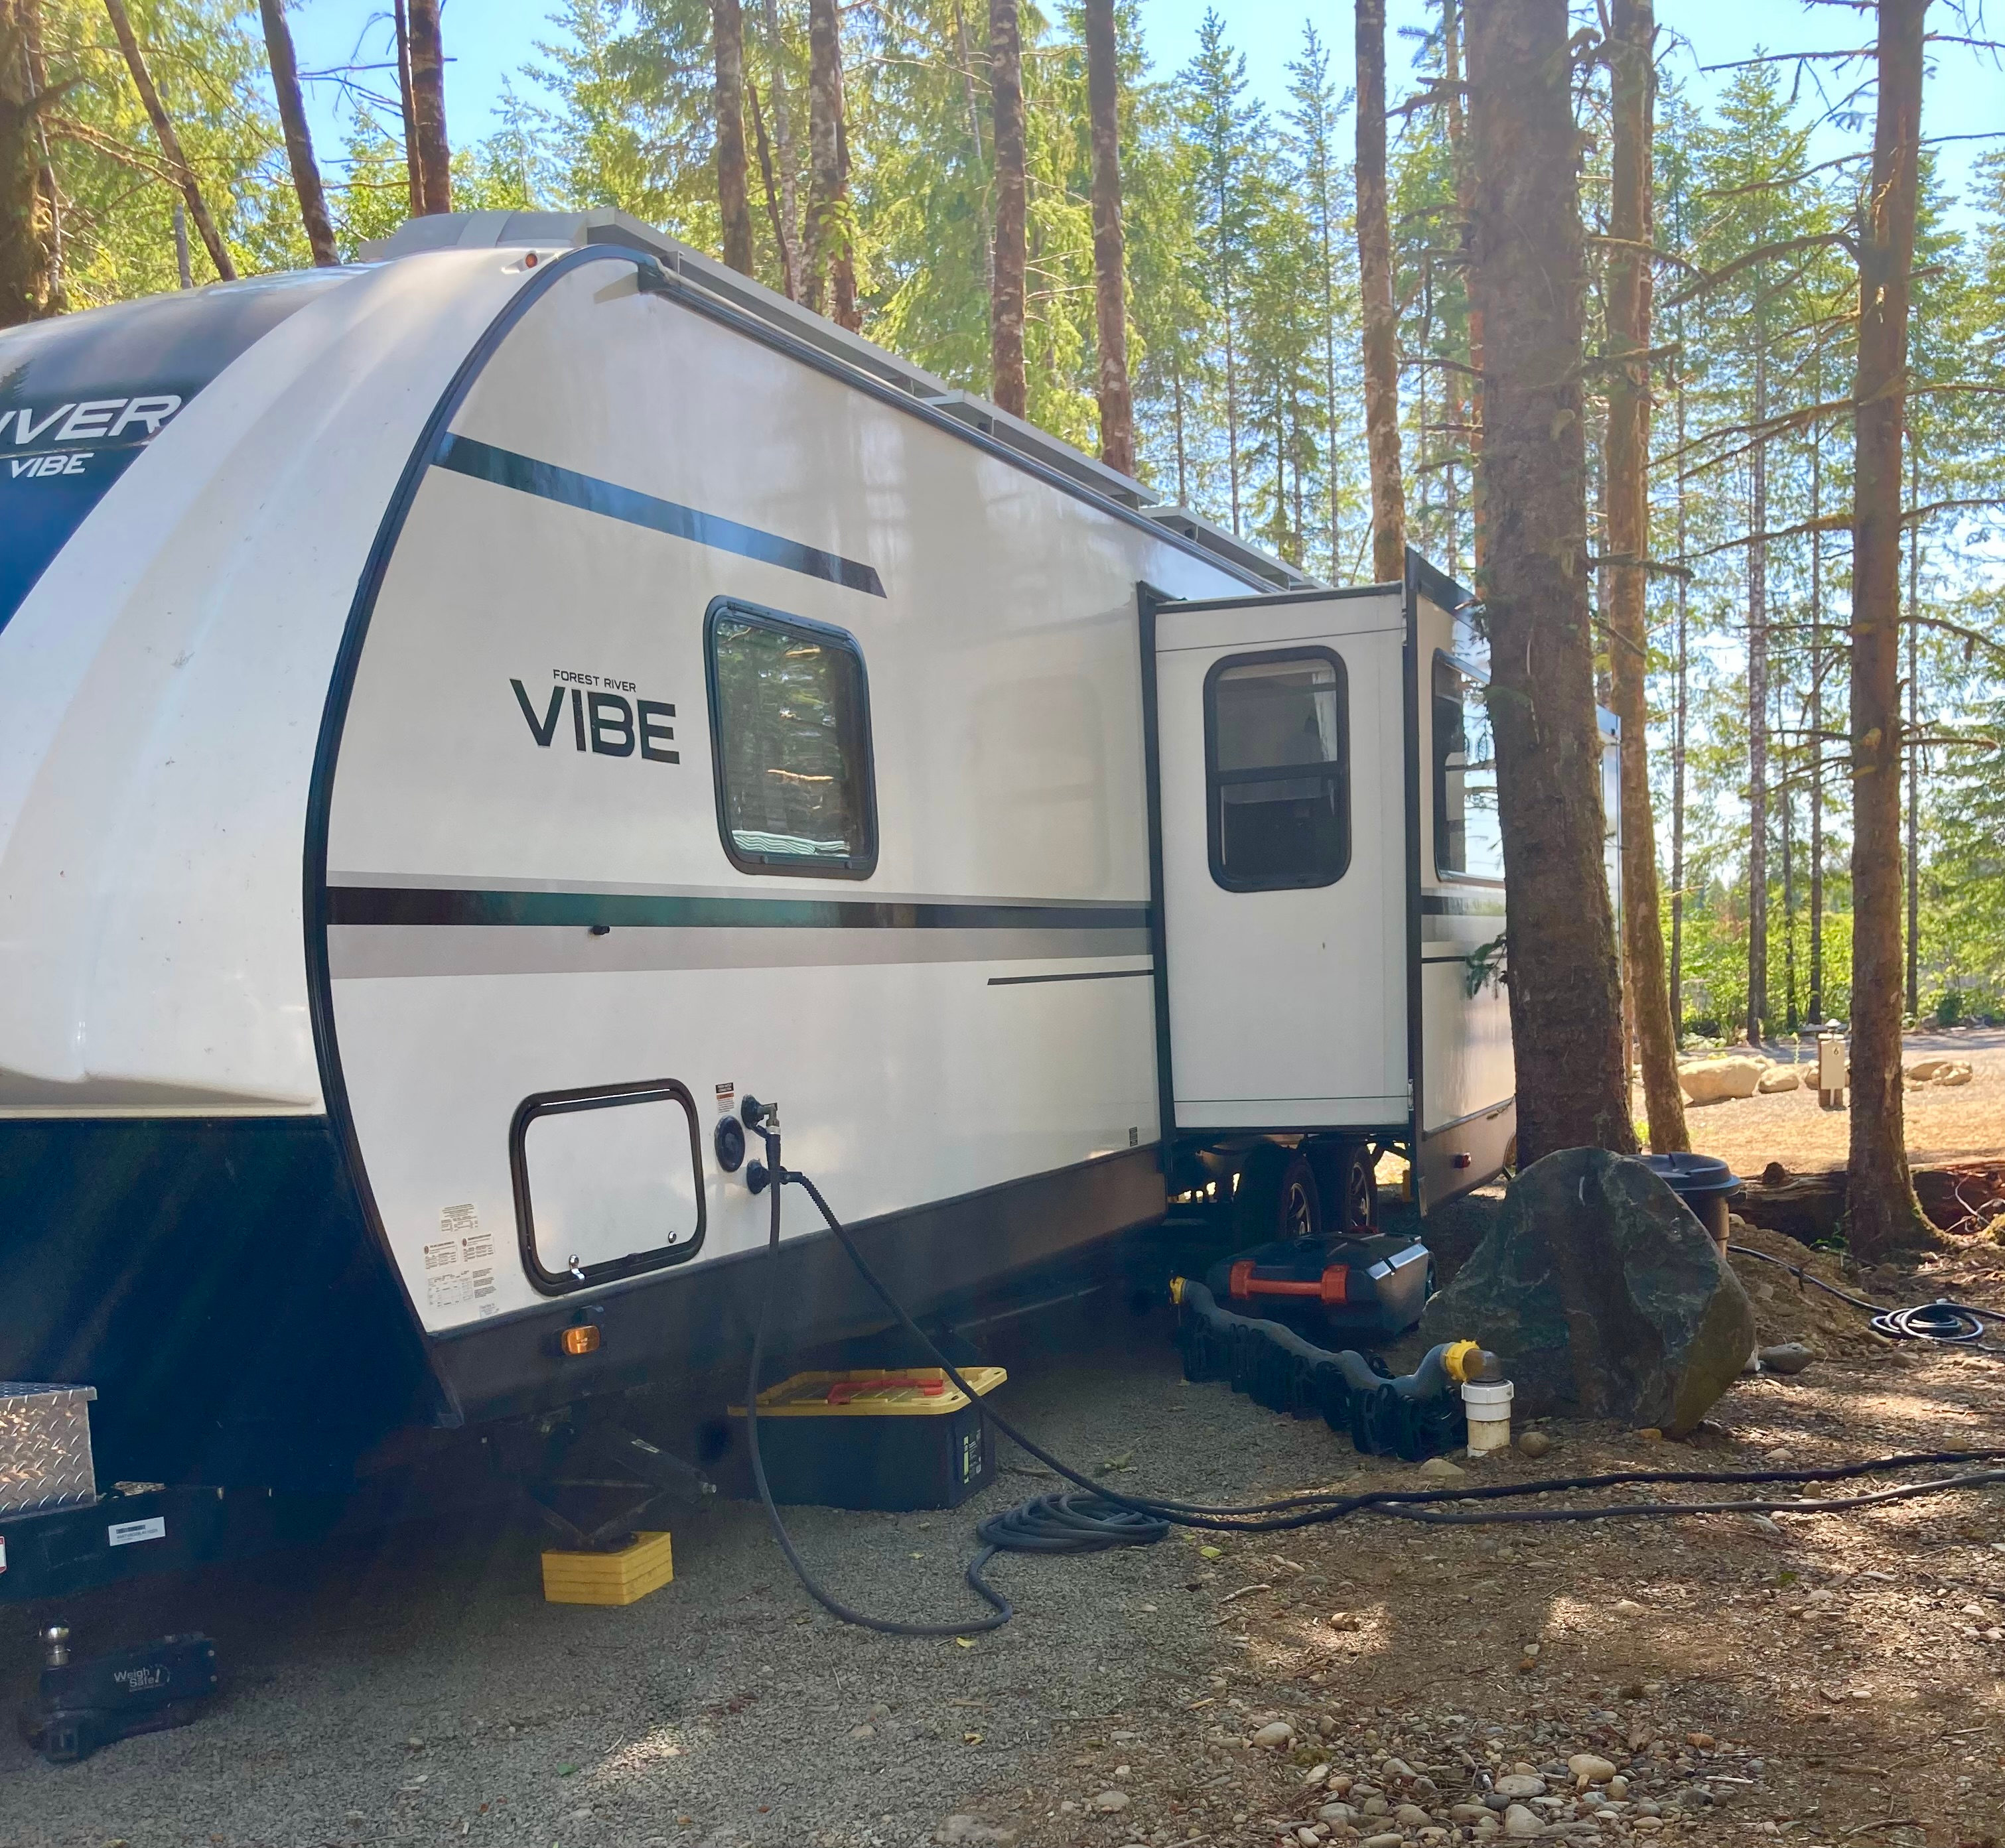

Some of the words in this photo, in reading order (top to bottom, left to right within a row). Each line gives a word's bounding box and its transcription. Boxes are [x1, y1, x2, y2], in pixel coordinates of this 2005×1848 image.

[11, 452, 95, 479] VIBE
[553, 669, 600, 687] FOREST
[604, 678, 637, 693] RIVER
[509, 679, 680, 765] VIBE
[113, 1667, 150, 1682] Weigh
